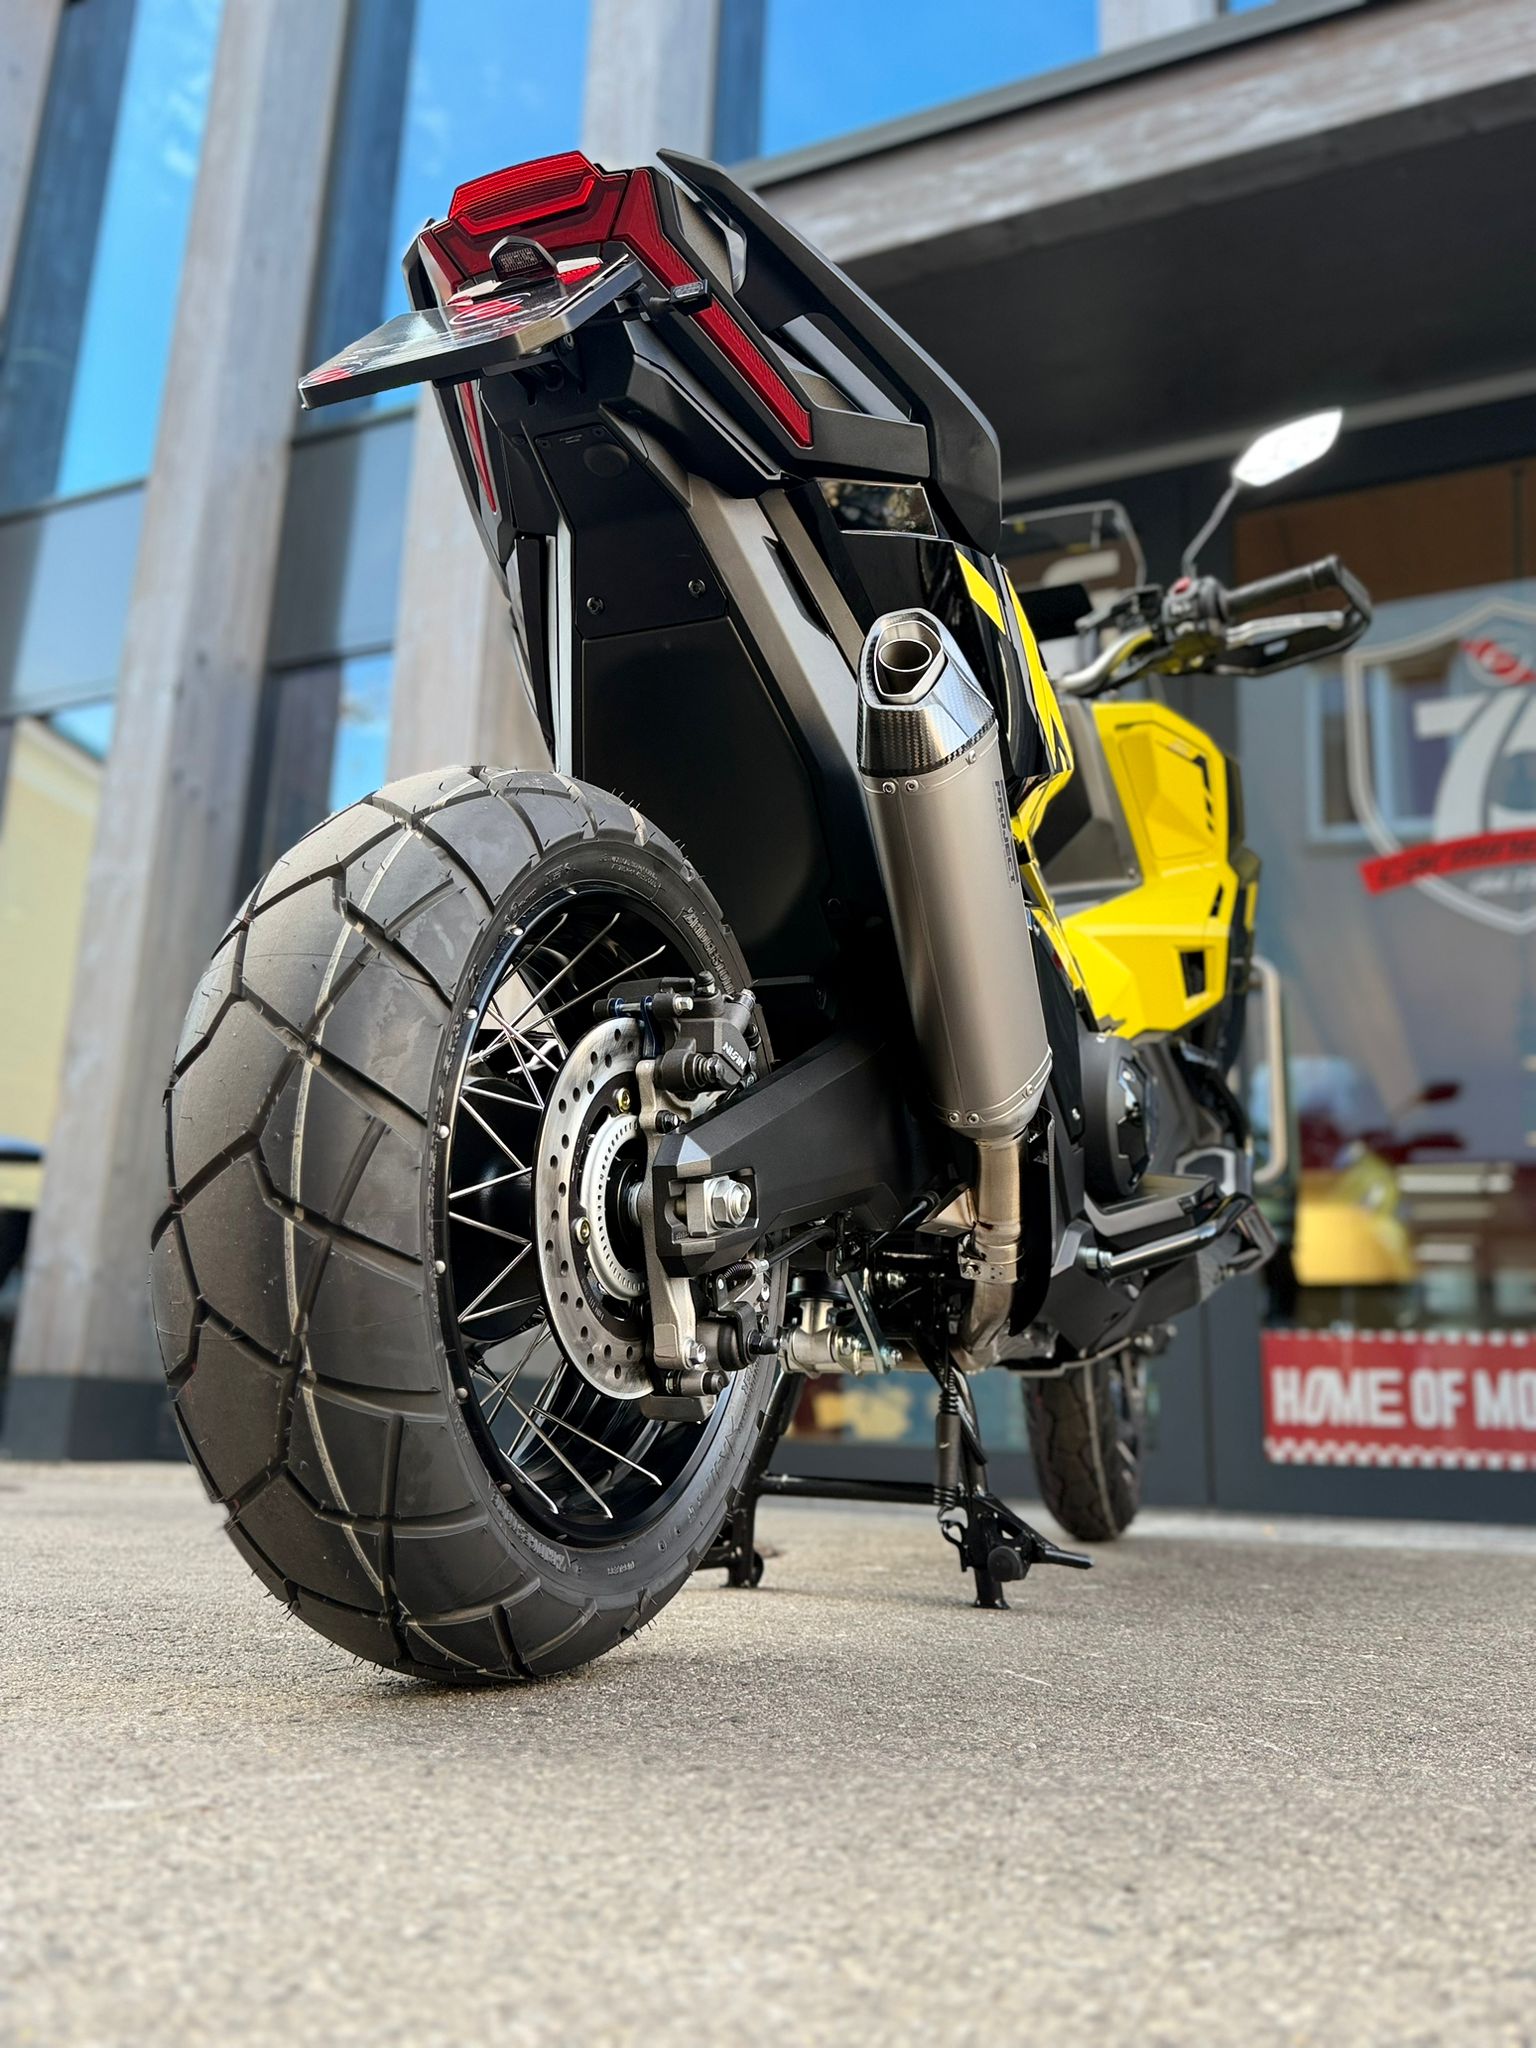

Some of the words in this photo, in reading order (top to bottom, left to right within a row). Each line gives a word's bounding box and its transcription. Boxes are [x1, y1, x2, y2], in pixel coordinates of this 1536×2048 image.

[1270, 1366, 1404, 1428] HOME
[1409, 1368, 1466, 1429] OF
[1471, 1368, 1536, 1431] MO
